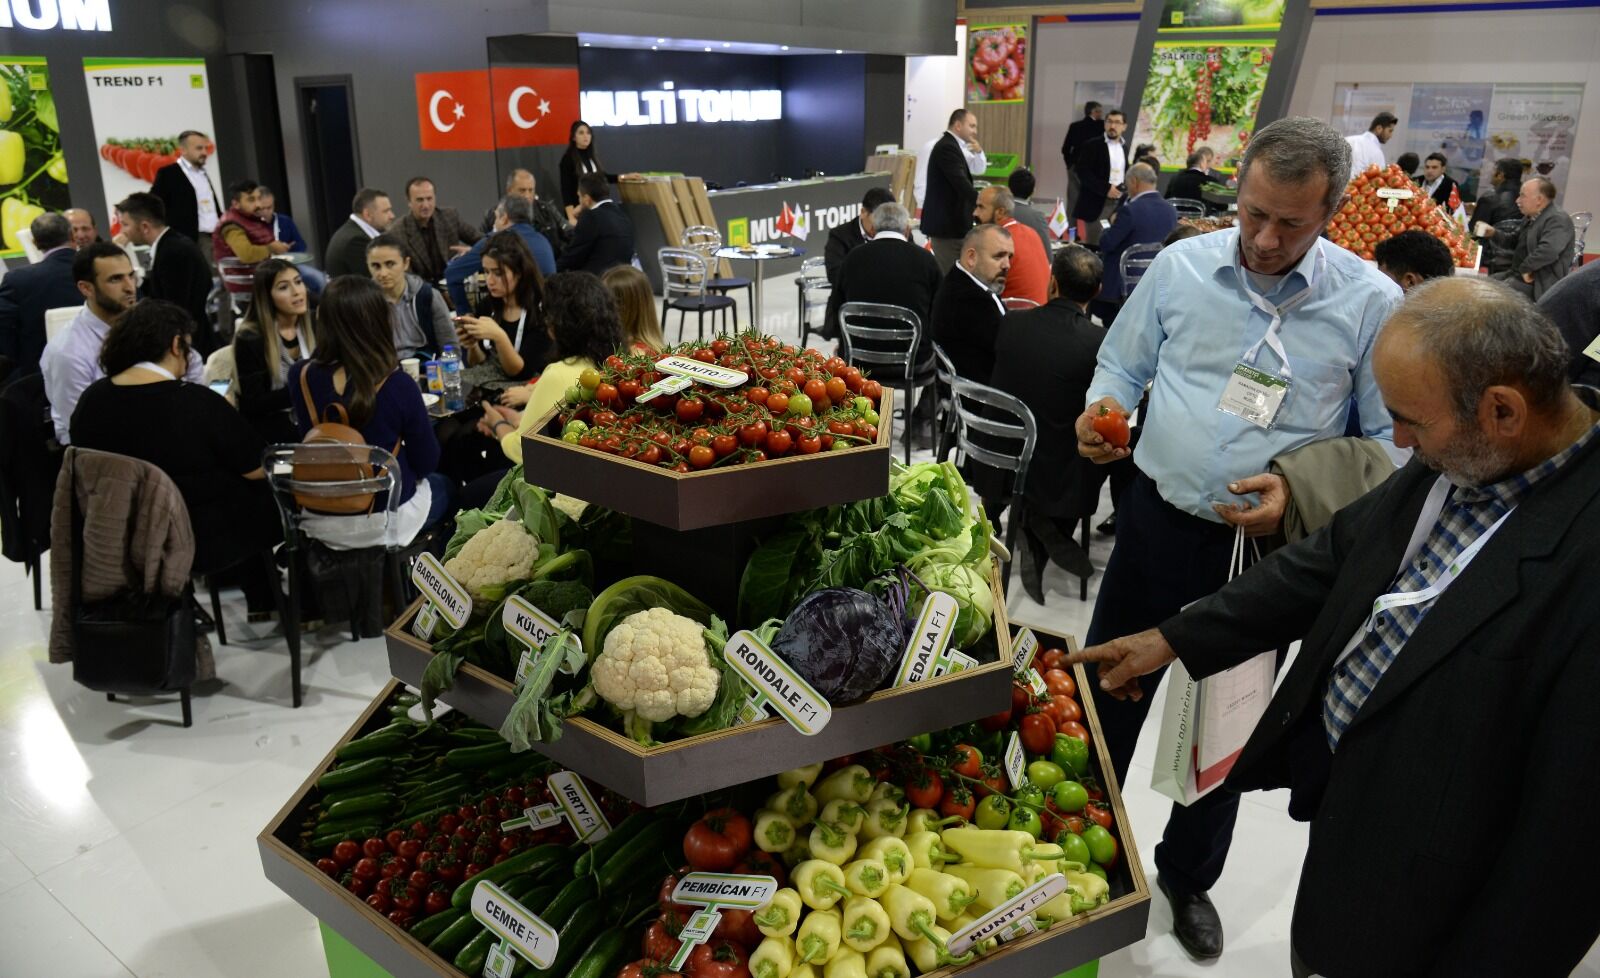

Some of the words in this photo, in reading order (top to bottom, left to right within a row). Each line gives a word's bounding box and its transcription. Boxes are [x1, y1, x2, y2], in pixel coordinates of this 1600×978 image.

[1161, 52, 1202, 61] SALKITO
[93, 76, 143, 87] TREND
[149, 76, 164, 87] F1
[1498, 112, 1529, 121] Green
[668, 360, 719, 377] SALKITO
[416, 561, 457, 612] BARCELONA
[456, 604, 466, 620] F1
[931, 610, 946, 629] F1
[735, 642, 803, 707] RONDALE
[799, 702, 818, 723] F1
[562, 783, 590, 816] VERTY
[582, 815, 597, 829] F1
[680, 881, 752, 897] PEMBİCAN
[751, 886, 768, 898] F1
[485, 899, 526, 940] CEMRE
[525, 930, 540, 950] F1
[969, 902, 1026, 942] HUNTY
[1031, 890, 1048, 905] F1
